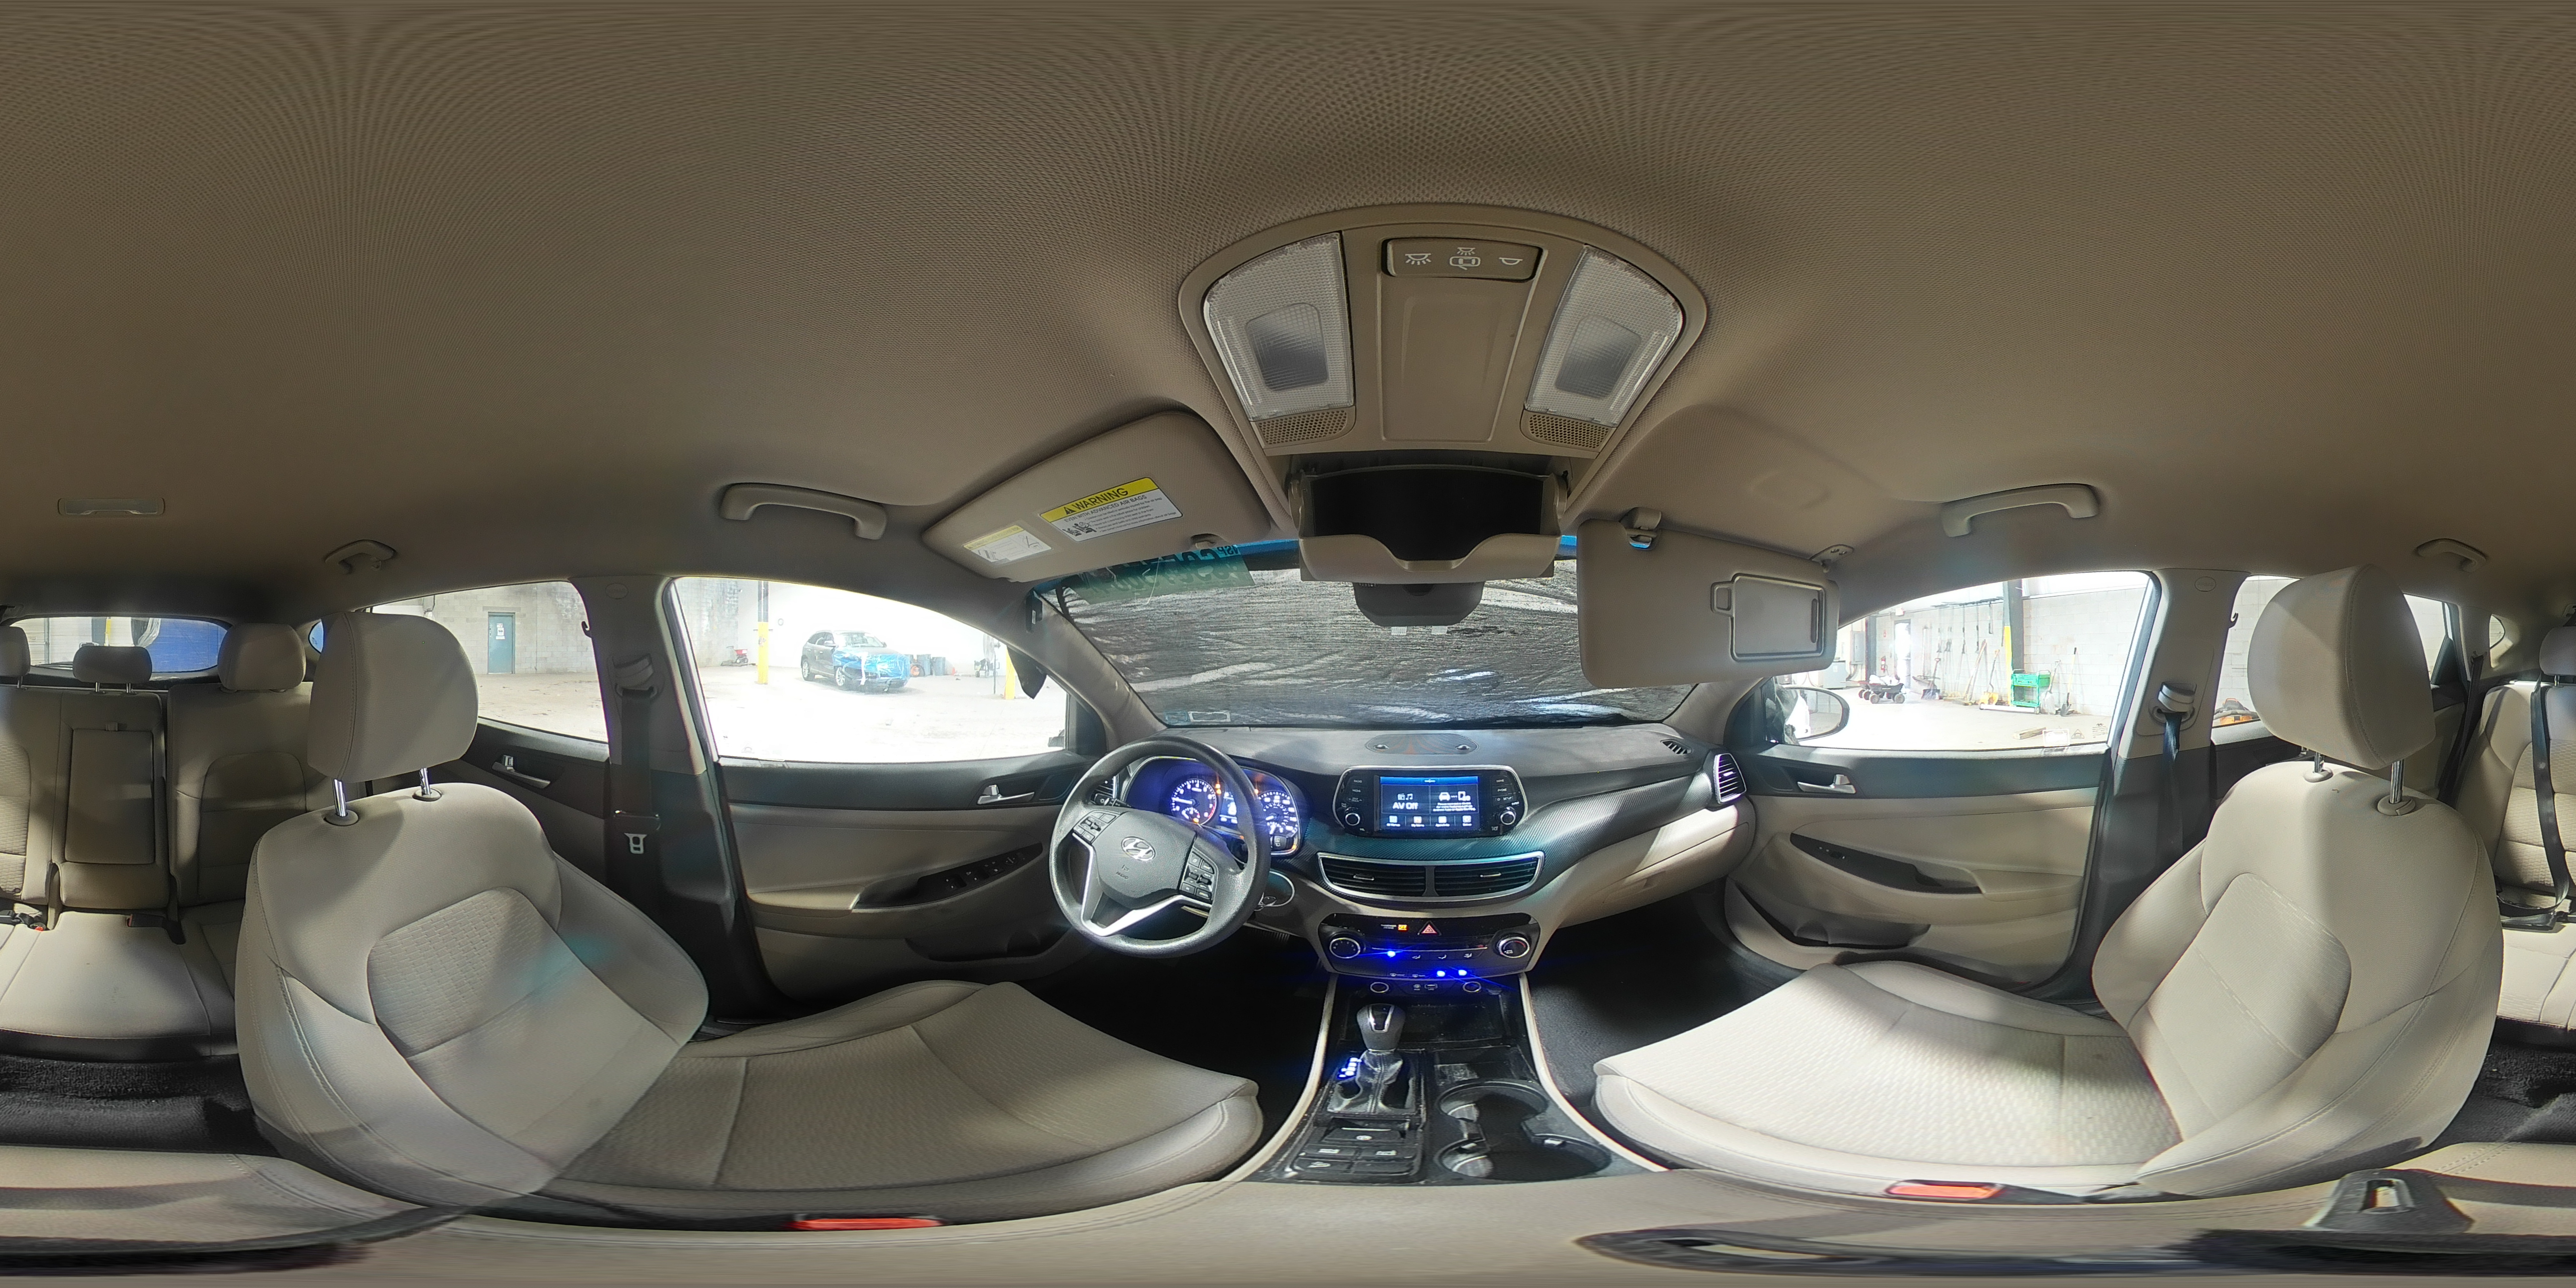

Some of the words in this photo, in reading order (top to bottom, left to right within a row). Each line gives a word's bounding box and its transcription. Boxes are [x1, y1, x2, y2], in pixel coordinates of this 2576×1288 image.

[1073, 488, 1128, 511] WARNING
[1090, 502, 1120, 515] ADVANCED
[1131, 494, 1148, 503] BAGS
